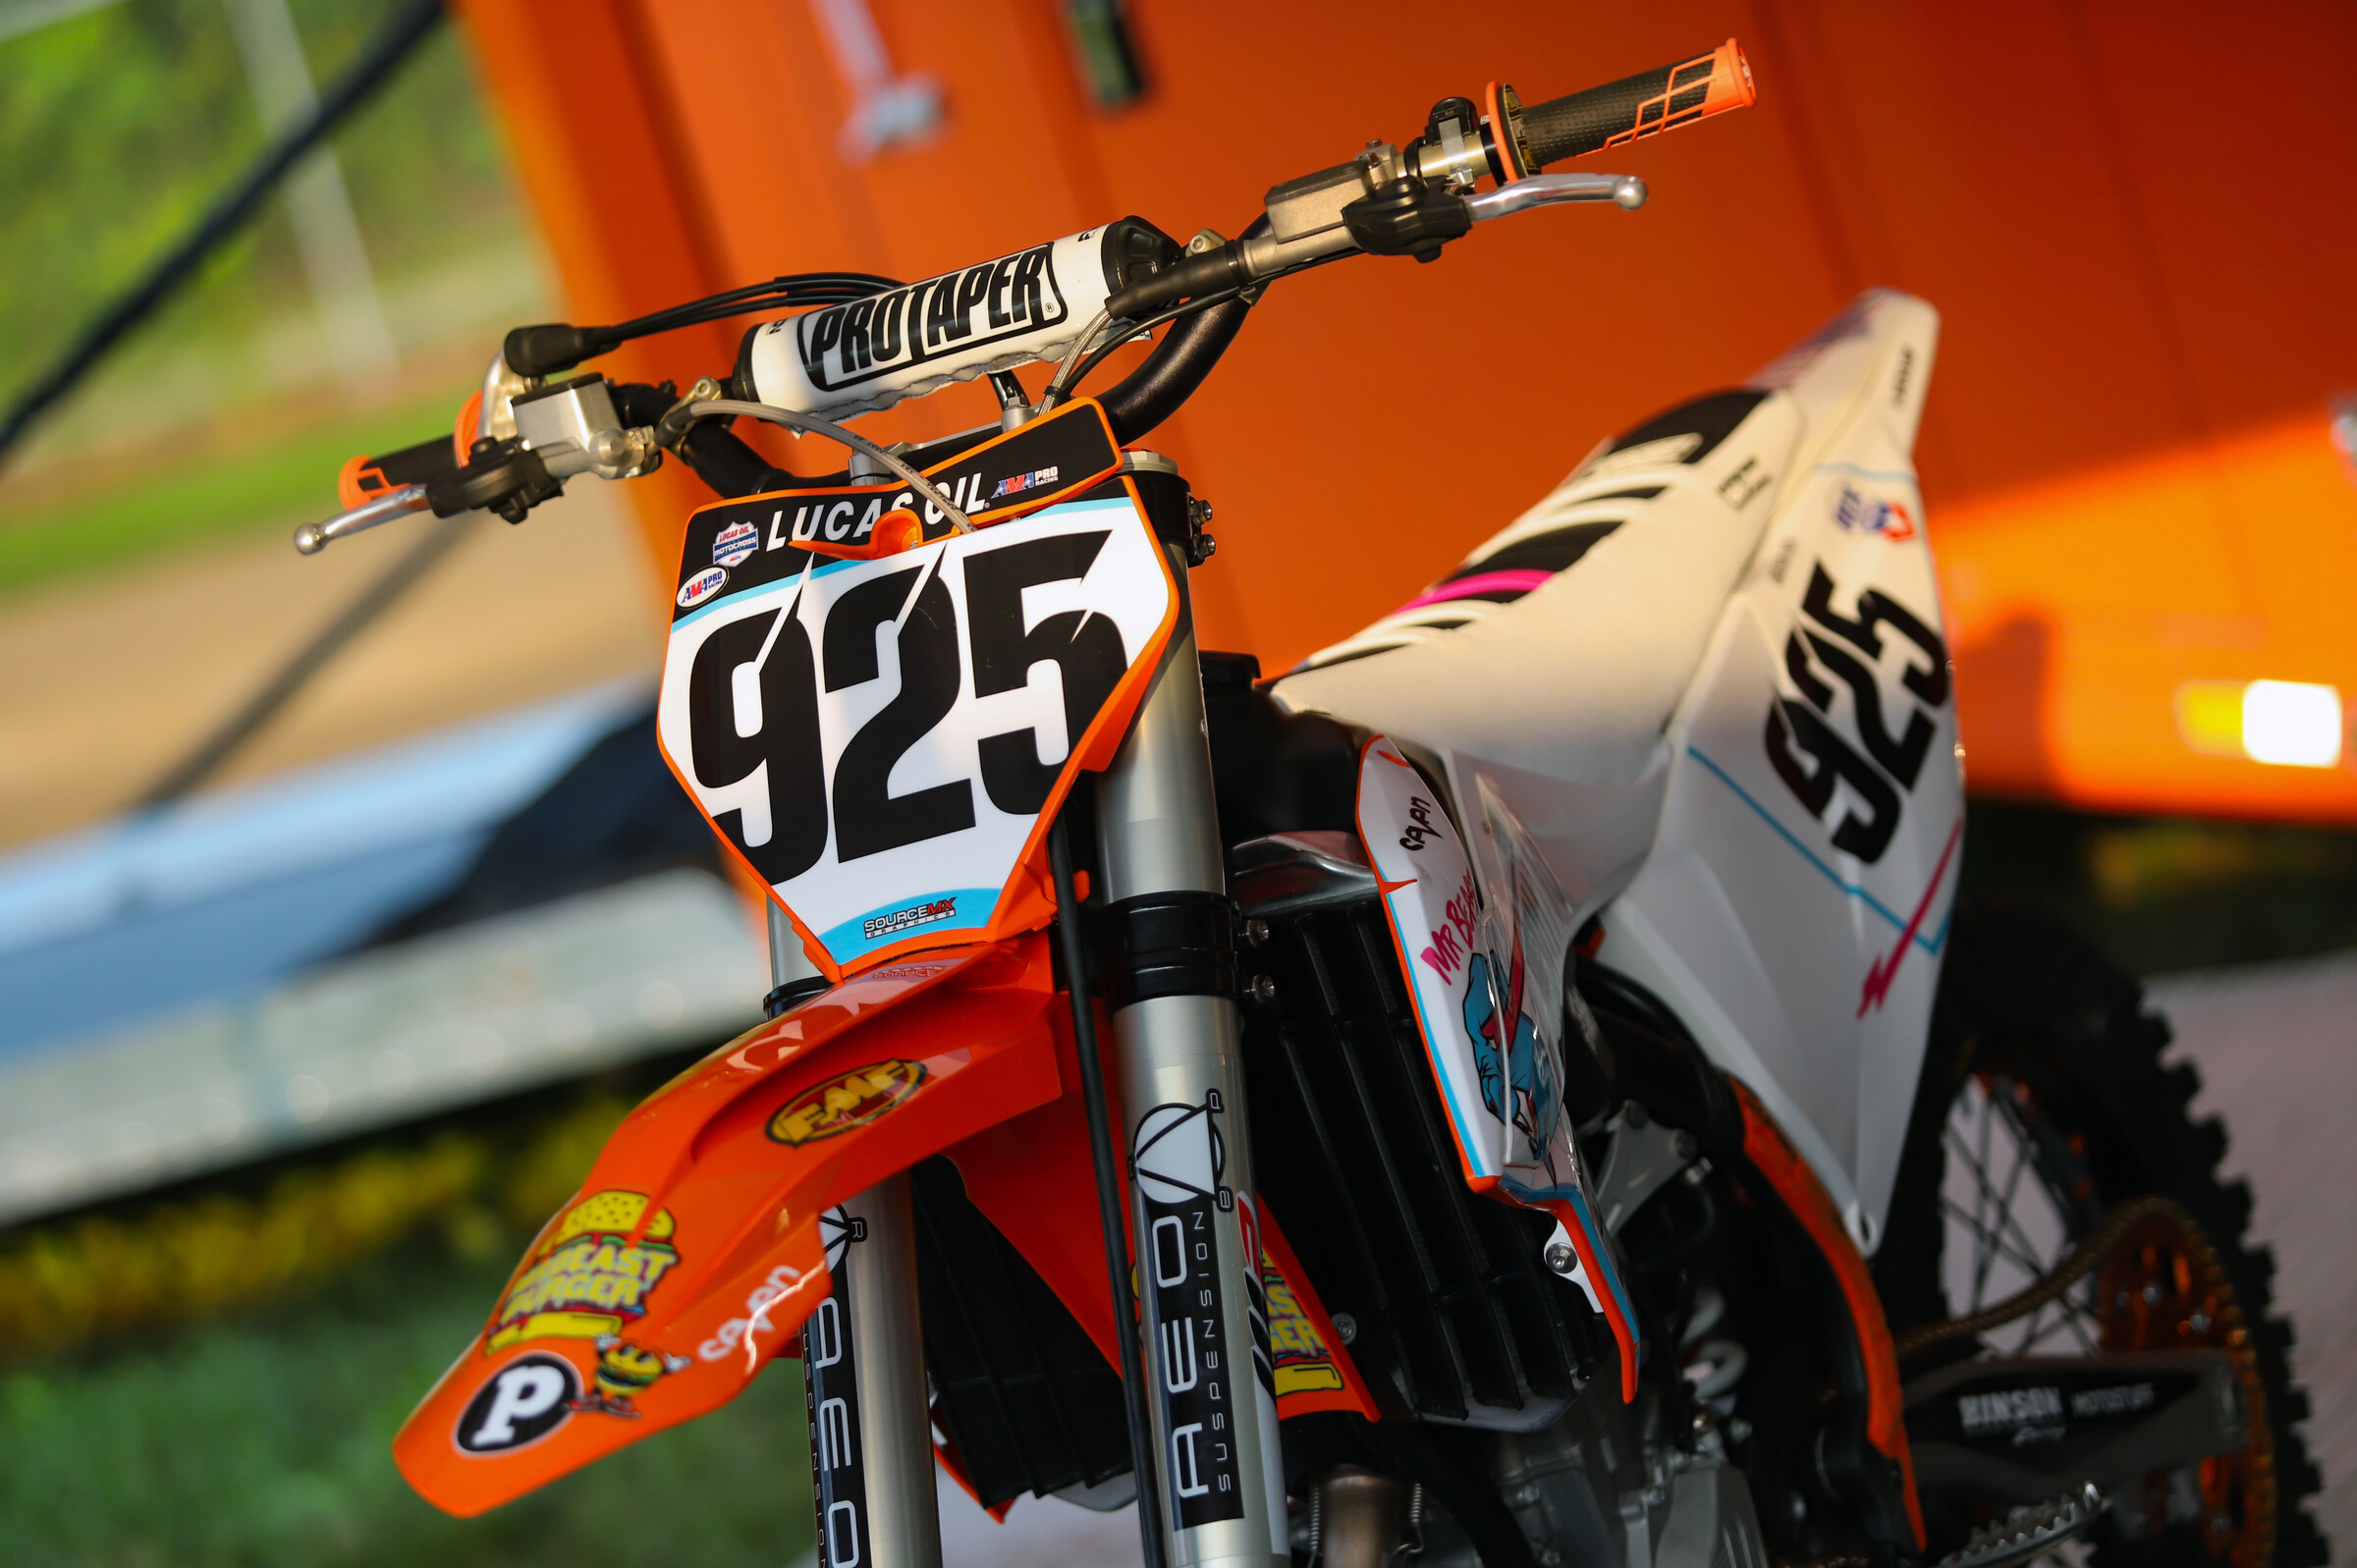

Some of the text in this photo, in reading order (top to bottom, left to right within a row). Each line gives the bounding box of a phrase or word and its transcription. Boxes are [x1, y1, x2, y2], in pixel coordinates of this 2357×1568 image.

[809, 252, 1049, 373] PROTAPER
[924, 472, 986, 525] OIL
[990, 465, 1059, 499] AMA PRO
[1034, 475, 1060, 487] RACING
[714, 536, 757, 557] MOTOCROSS
[719, 529, 740, 543] LUCAS
[739, 525, 750, 536] OIL
[681, 570, 723, 604] AMA PRO
[689, 528, 1128, 886] 925
[1764, 558, 1949, 864] 925
[1151, 1214, 1209, 1499] AEO
[1192, 1211, 1232, 1493] SUSPENSION
[471, 1365, 564, 1448] P
[802, 1325, 827, 1568] USPENSIO
[815, 1296, 860, 1568] AEO
